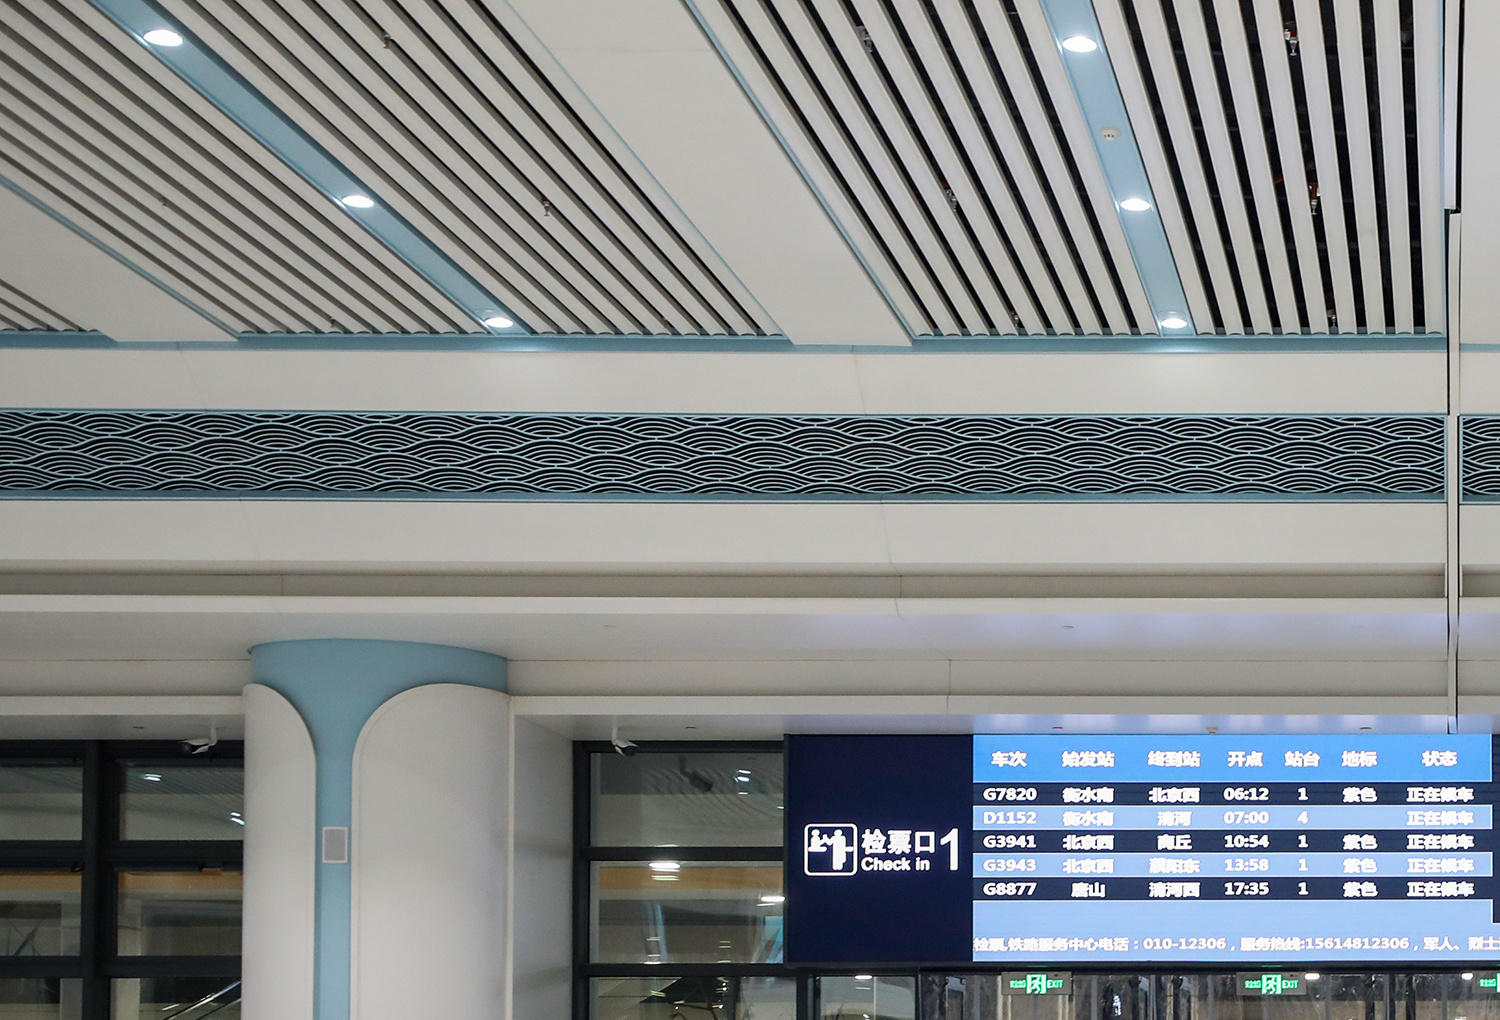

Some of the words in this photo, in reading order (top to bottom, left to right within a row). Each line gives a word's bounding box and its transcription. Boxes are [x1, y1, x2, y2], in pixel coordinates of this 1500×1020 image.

[991, 750, 1028, 768] 车次
[1061, 750, 1115, 768] 始发站
[1147, 750, 1201, 768] 终到站
[1227, 750, 1264, 768] 开点
[1284, 750, 1321, 768] 站台
[1341, 750, 1378, 767] 地标
[1421, 750, 1458, 767] 状态
[983, 787, 1037, 801] G7820
[1148, 787, 1201, 803] 北京西
[1223, 787, 1269, 801] 06:12
[1297, 787, 1309, 801] 1
[1342, 786, 1378, 803] 紫色
[1406, 786, 1475, 803] 正在候车
[983, 811, 1037, 824] D1152
[1157, 810, 1192, 827] 清河
[1223, 811, 1269, 824] 07:00
[1297, 811, 1309, 824] 4
[1406, 810, 1474, 826] 正在候车
[861, 828, 935, 854] 检票口
[940, 828, 959, 871] 1
[983, 834, 1037, 848] G3941
[1062, 834, 1115, 851] 北京西
[1156, 833, 1193, 851] 商丘
[1224, 834, 1270, 848] 10:54
[1298, 834, 1309, 848] 1
[1342, 833, 1378, 850] 紫色
[1406, 833, 1475, 850] 正在候车
[861, 857, 910, 871] Check
[915, 857, 930, 871] in
[983, 859, 1037, 872] G3943
[1062, 858, 1115, 874] 北京西
[1224, 858, 1270, 871] 13:58
[1298, 858, 1308, 871] 1
[1342, 857, 1378, 874] 紫色
[1406, 857, 1475, 873] 正在候车
[983, 882, 1037, 896] G8877
[1070, 881, 1106, 898] 唐山
[1148, 881, 1201, 898] 清河西
[1224, 881, 1270, 896] 17:35
[1298, 881, 1309, 895] 1
[1342, 881, 1379, 898] 紫色
[1406, 881, 1475, 898] 正在候车
[1049, 979, 1064, 989] EXIT
[1284, 979, 1299, 989] EXIT
